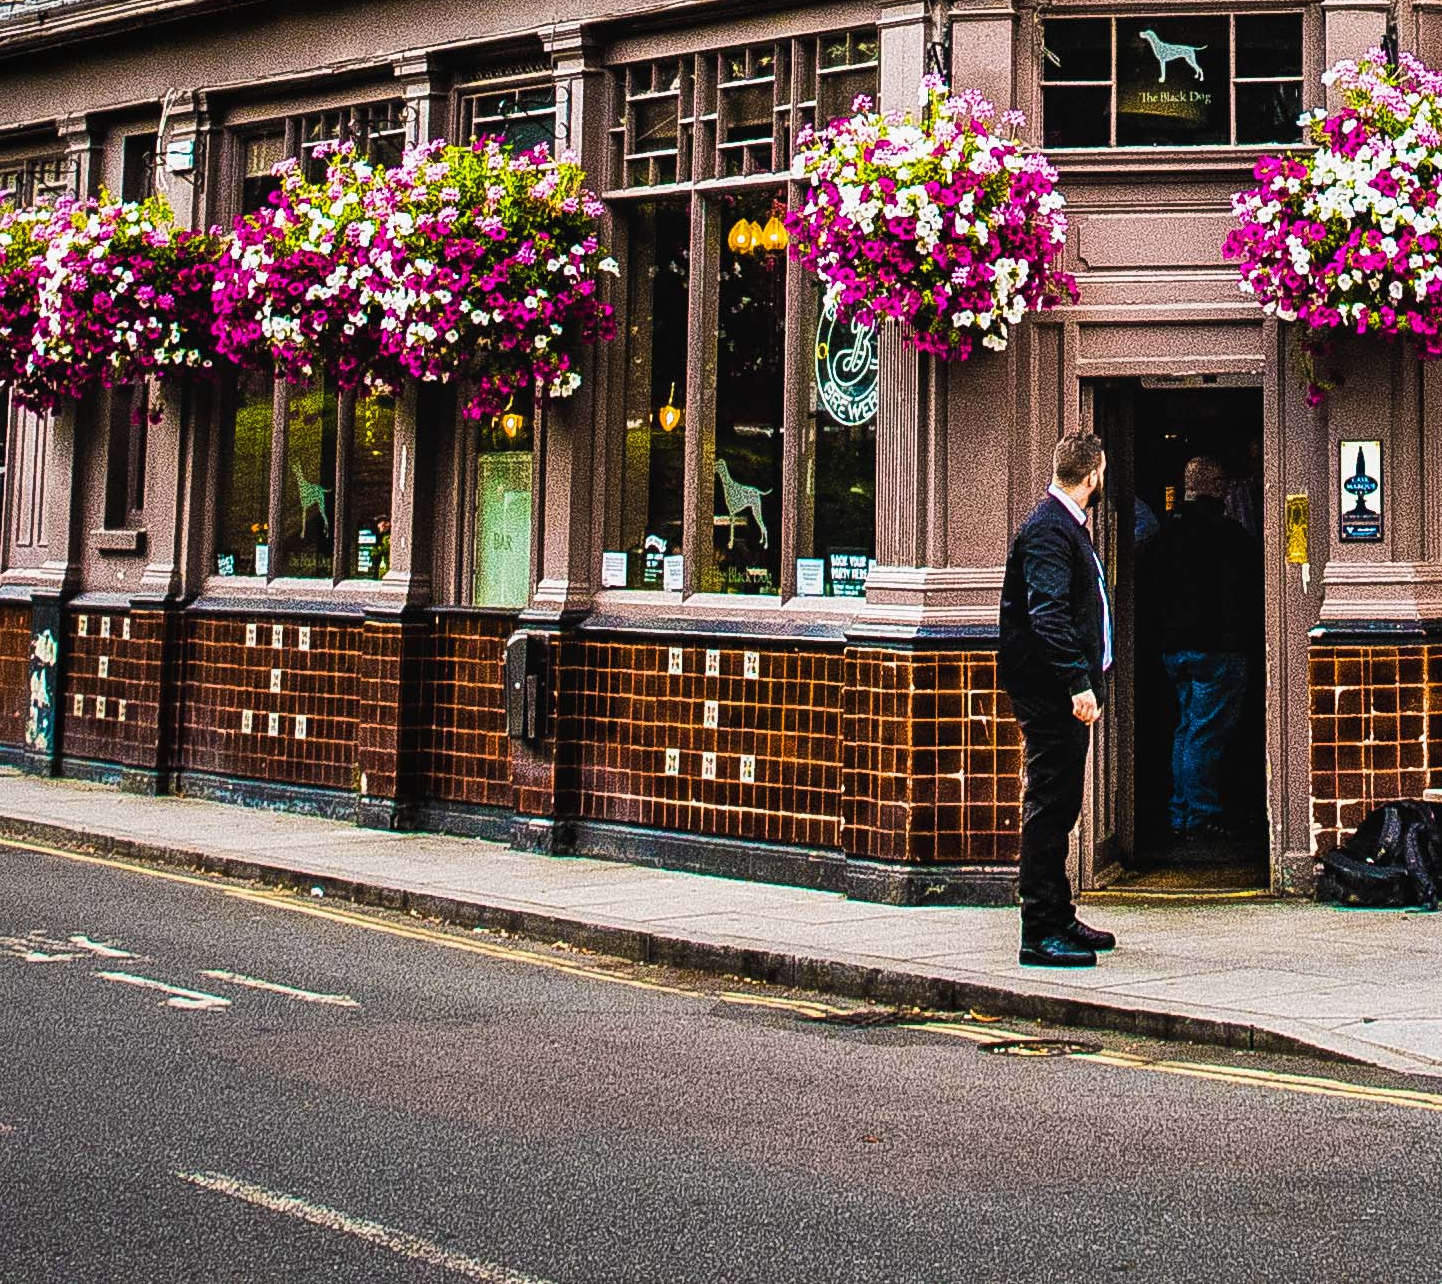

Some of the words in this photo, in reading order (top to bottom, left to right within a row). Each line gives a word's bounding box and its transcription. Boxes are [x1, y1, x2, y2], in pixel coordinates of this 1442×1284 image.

[1139, 91, 1158, 103] The
[1160, 91, 1187, 103] Black
[1189, 91, 1211, 105] Dog
[824, 382, 879, 421] BREWER
